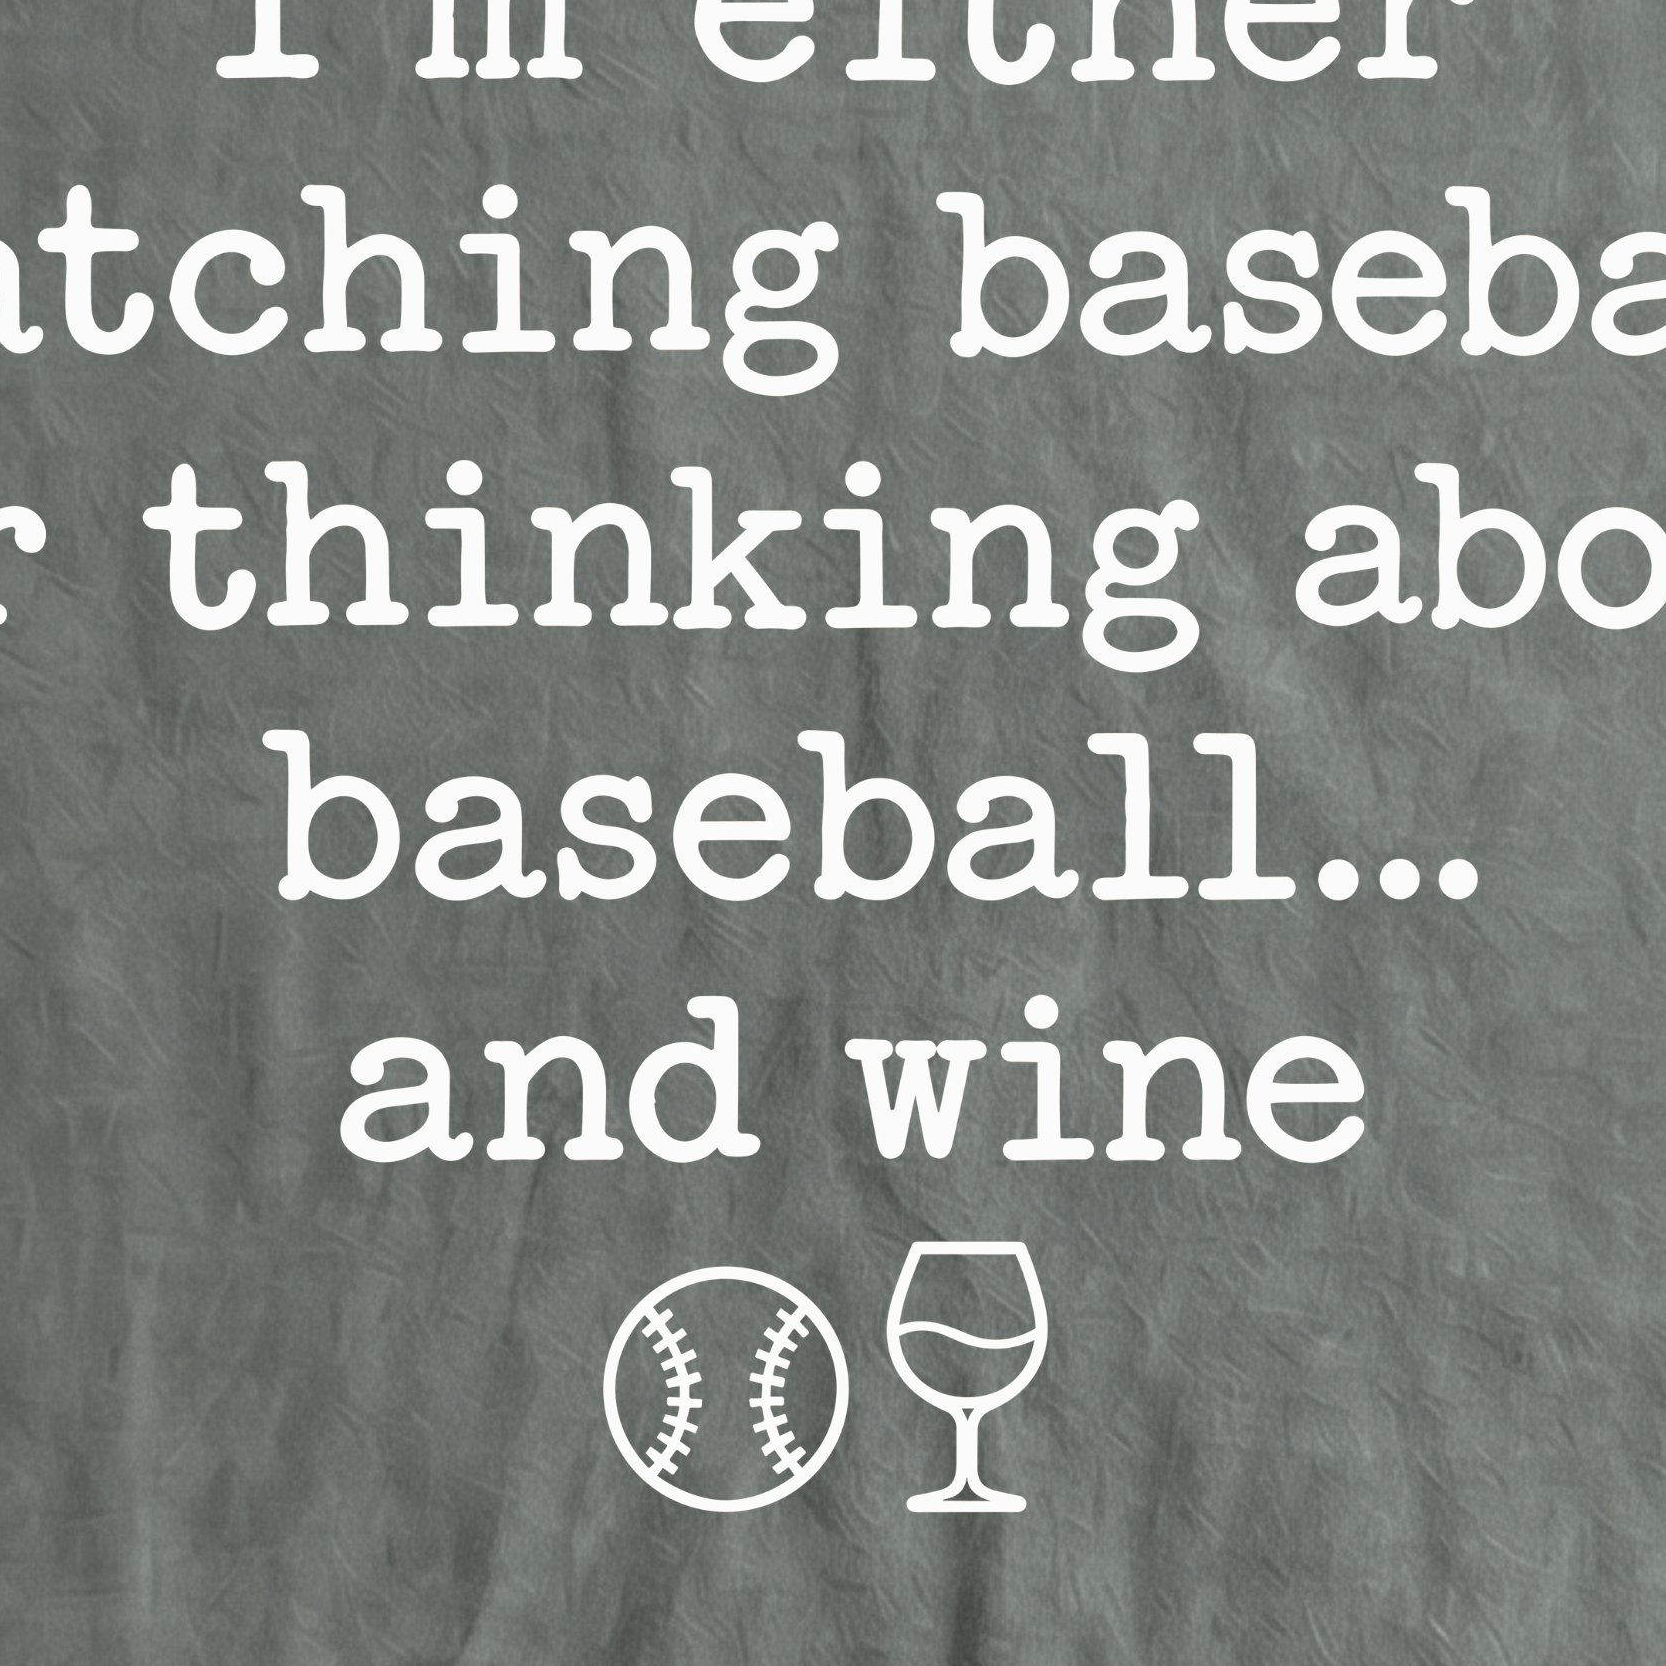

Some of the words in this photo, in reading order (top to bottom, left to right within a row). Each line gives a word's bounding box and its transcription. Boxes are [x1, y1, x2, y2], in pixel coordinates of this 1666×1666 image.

[143, 460, 1199, 672] thinking
[262, 730, 1478, 901] baseball...
[340, 996, 760, 1163] and
[845, 995, 1364, 1163] wine
